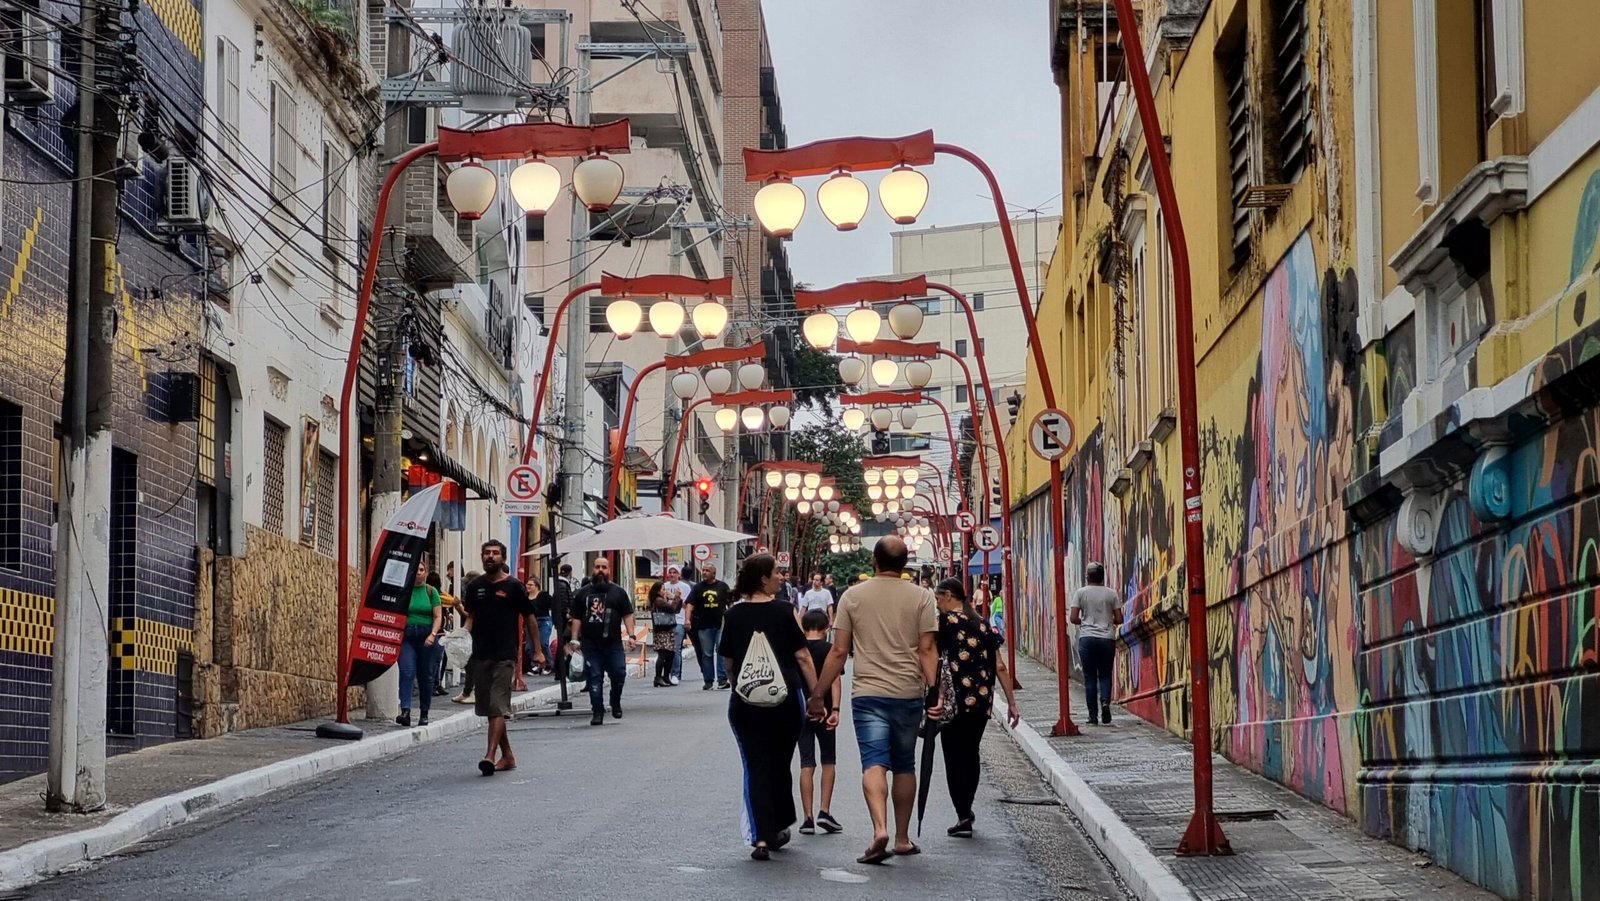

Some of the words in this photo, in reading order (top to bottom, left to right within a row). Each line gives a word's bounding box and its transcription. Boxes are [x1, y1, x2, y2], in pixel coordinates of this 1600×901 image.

[1042, 418, 1060, 450] E
[517, 473, 530, 492] E
[961, 514, 970, 528] E
[982, 530, 993, 546] E
[372, 612, 397, 624] SHIATSU
[361, 625, 377, 636] QUICK
[376, 629, 401, 641] MASSAGE
[359, 640, 397, 655] REFLEXOLOGIA
[367, 651, 385, 662] PODAL
[741, 662, 775, 680] Berlin
